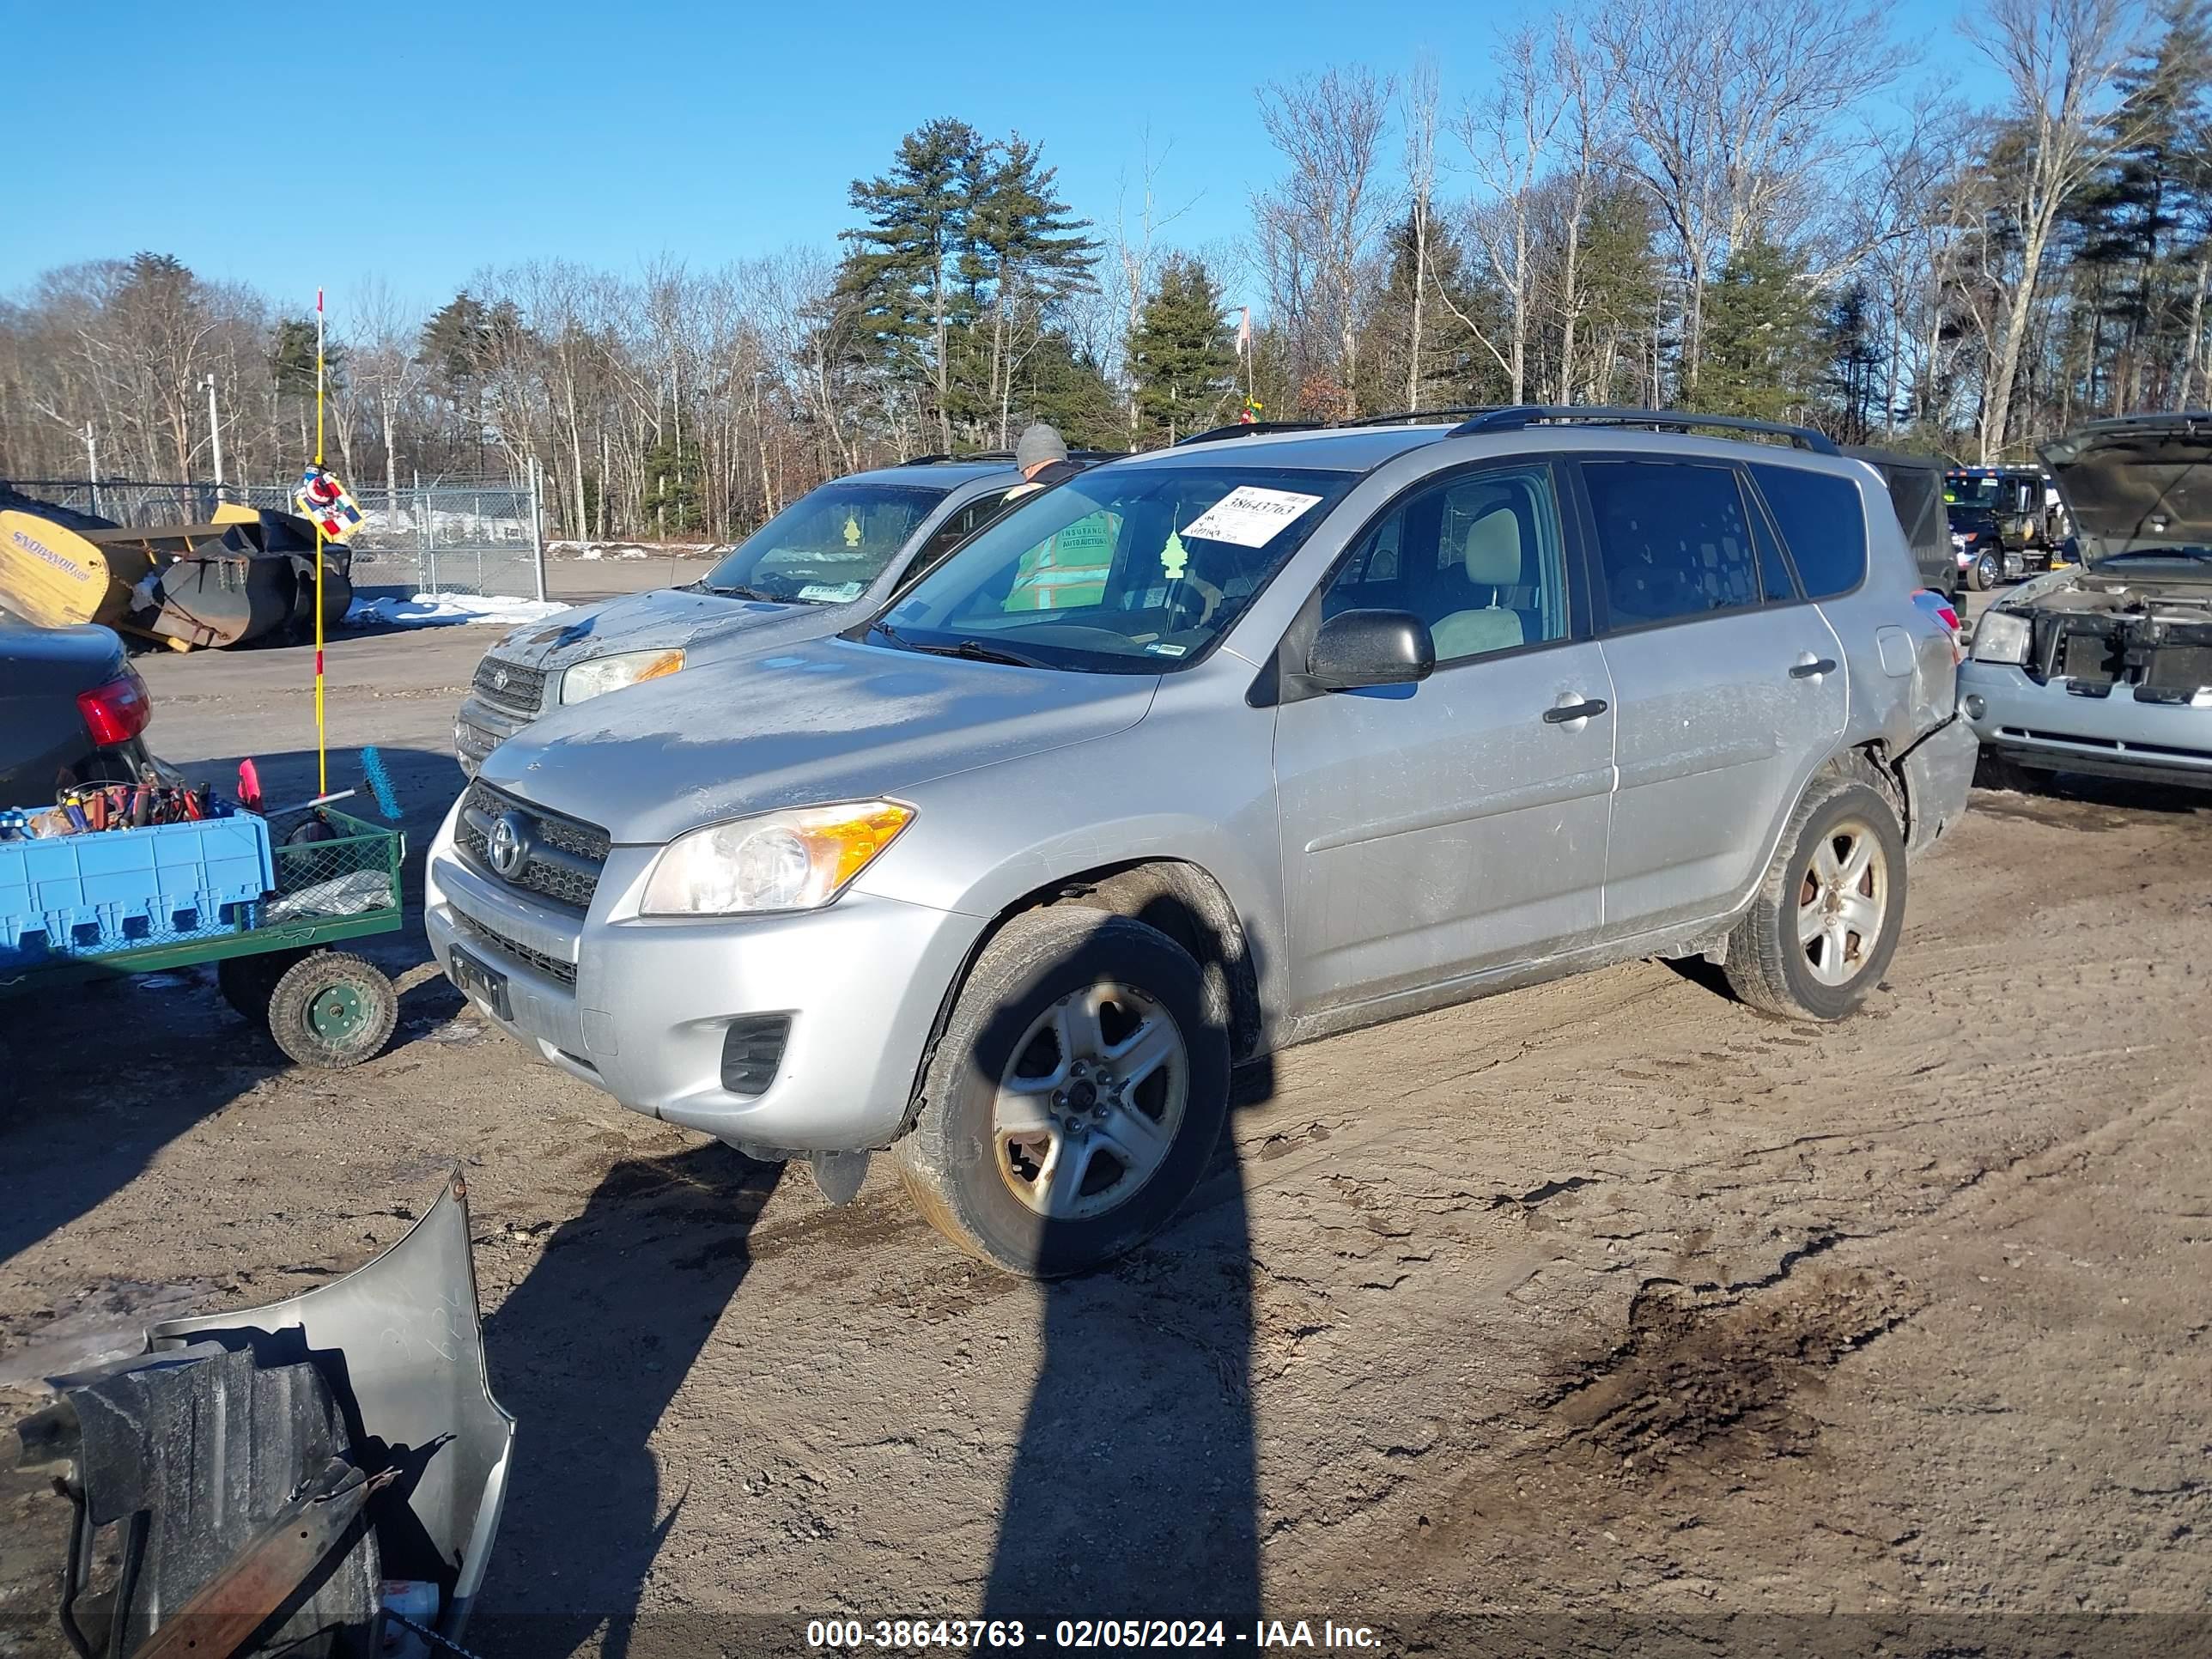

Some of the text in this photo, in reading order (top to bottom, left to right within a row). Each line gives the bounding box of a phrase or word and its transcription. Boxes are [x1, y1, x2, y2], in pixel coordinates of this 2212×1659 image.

[1224, 497, 1296, 515] 38643763
[1061, 527, 1107, 537] INSURANCE
[1063, 538, 1080, 548] AUTO
